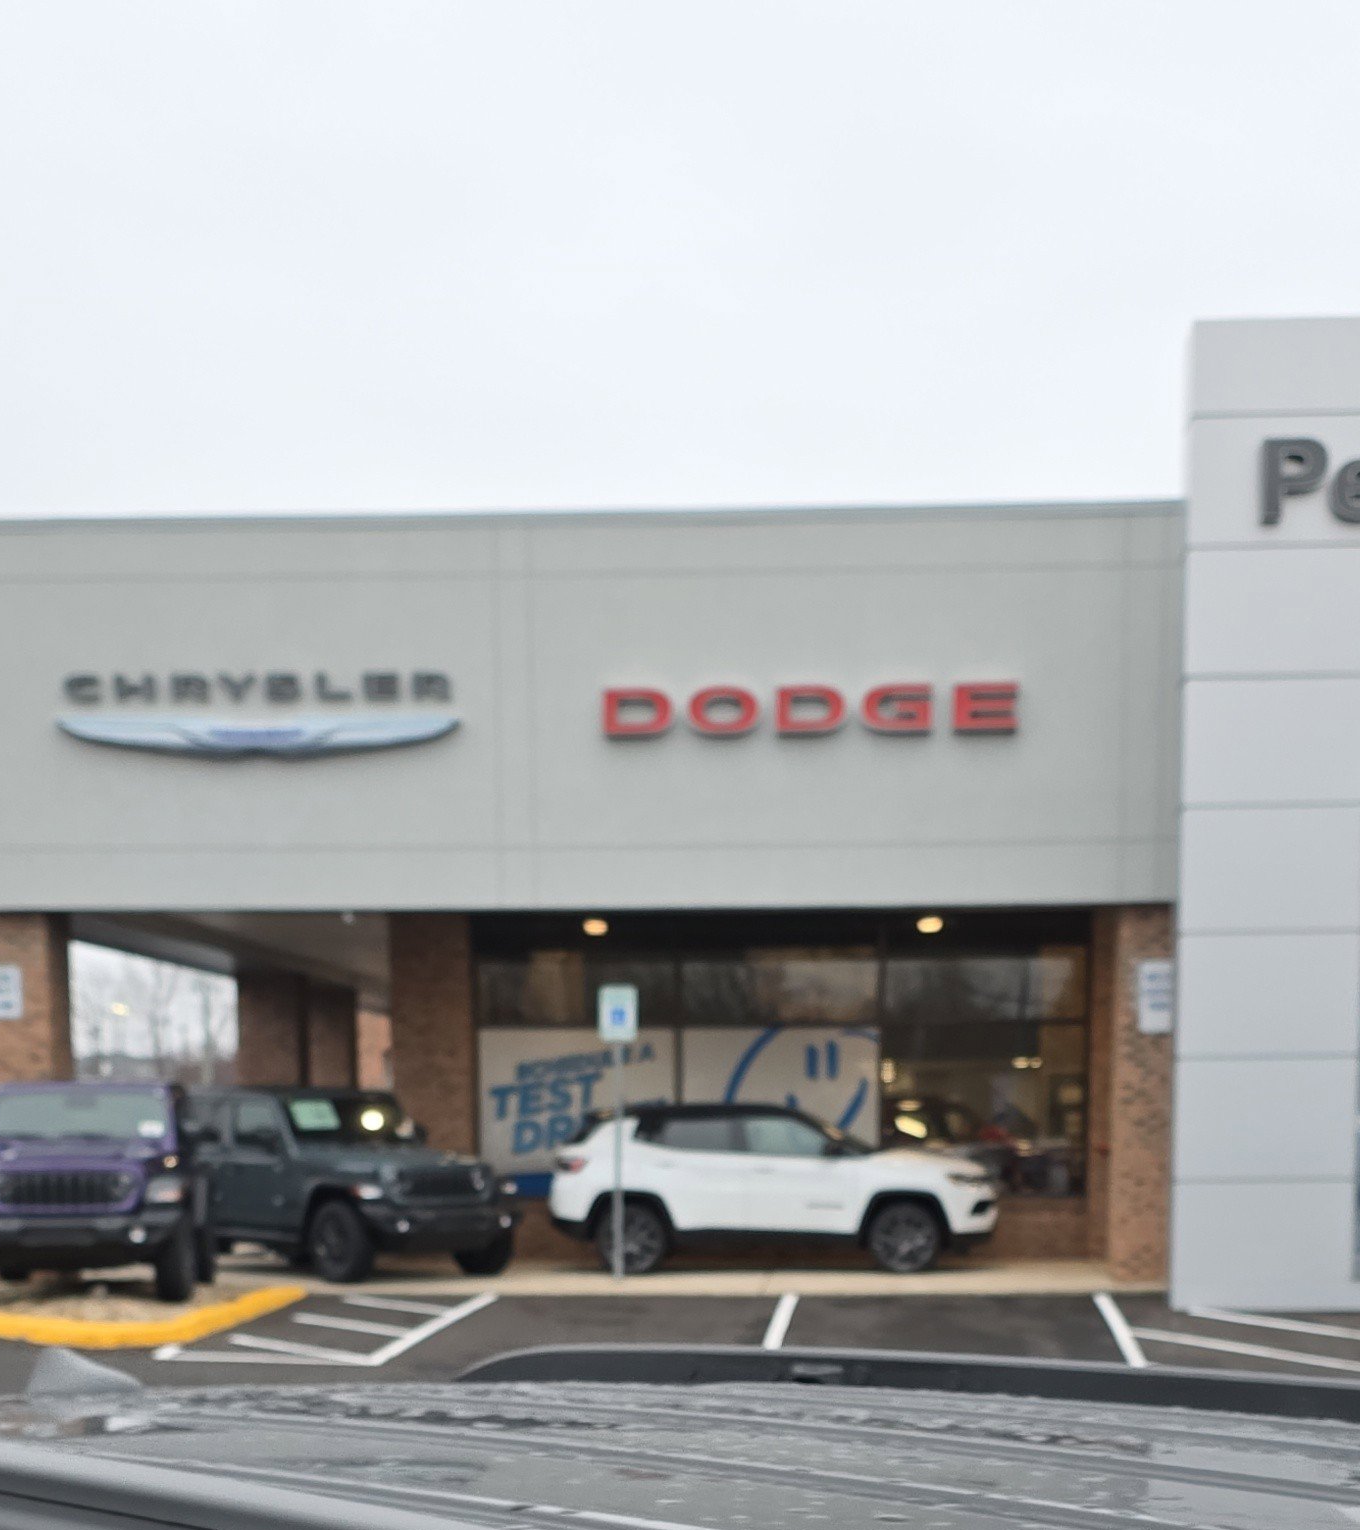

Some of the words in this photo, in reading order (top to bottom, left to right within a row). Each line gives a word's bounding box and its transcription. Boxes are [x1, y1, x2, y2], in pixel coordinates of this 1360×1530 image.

[62, 670, 452, 704] CHRYSLER
[600, 680, 1022, 738] DODGE
[490, 1072, 602, 1120] TEST
